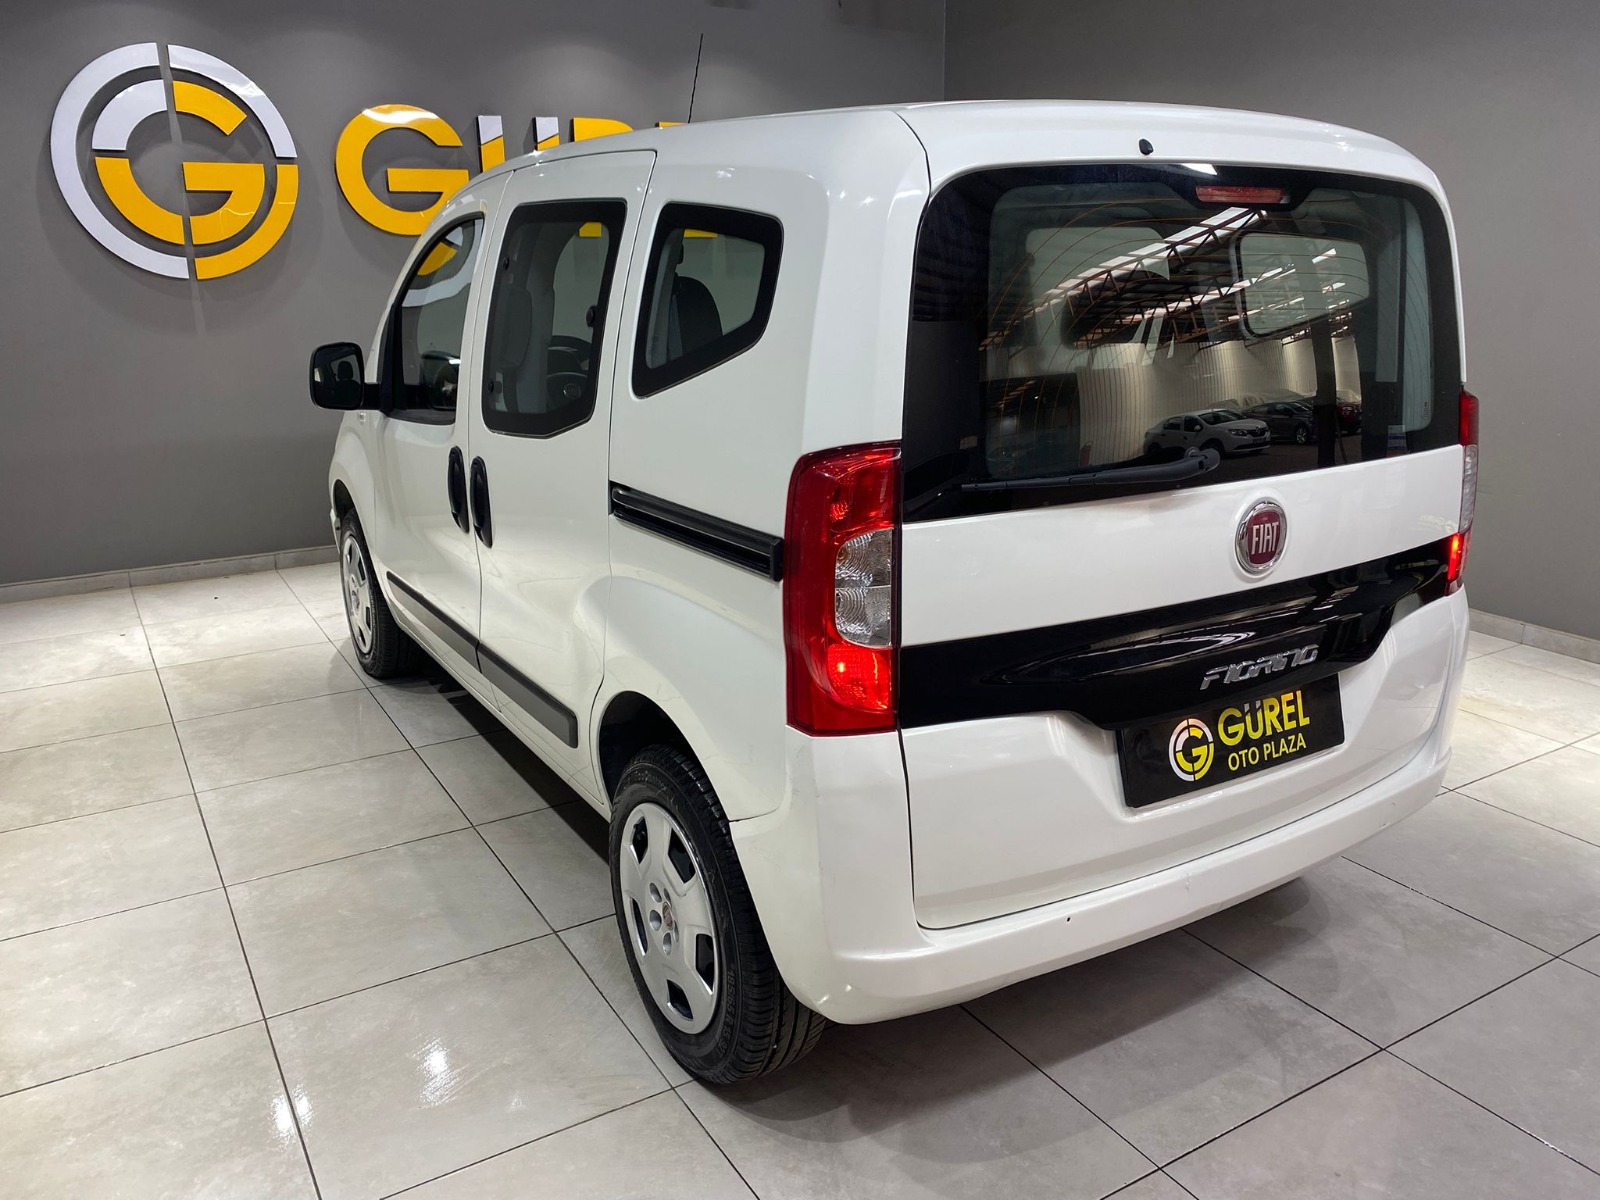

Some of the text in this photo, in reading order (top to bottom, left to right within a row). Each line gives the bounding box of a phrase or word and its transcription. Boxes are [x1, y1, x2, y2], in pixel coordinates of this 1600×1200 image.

[1251, 521, 1279, 555] FIAT
[1200, 644, 1319, 690] FIORINO
[1228, 732, 1307, 771] OTO PLAZA
